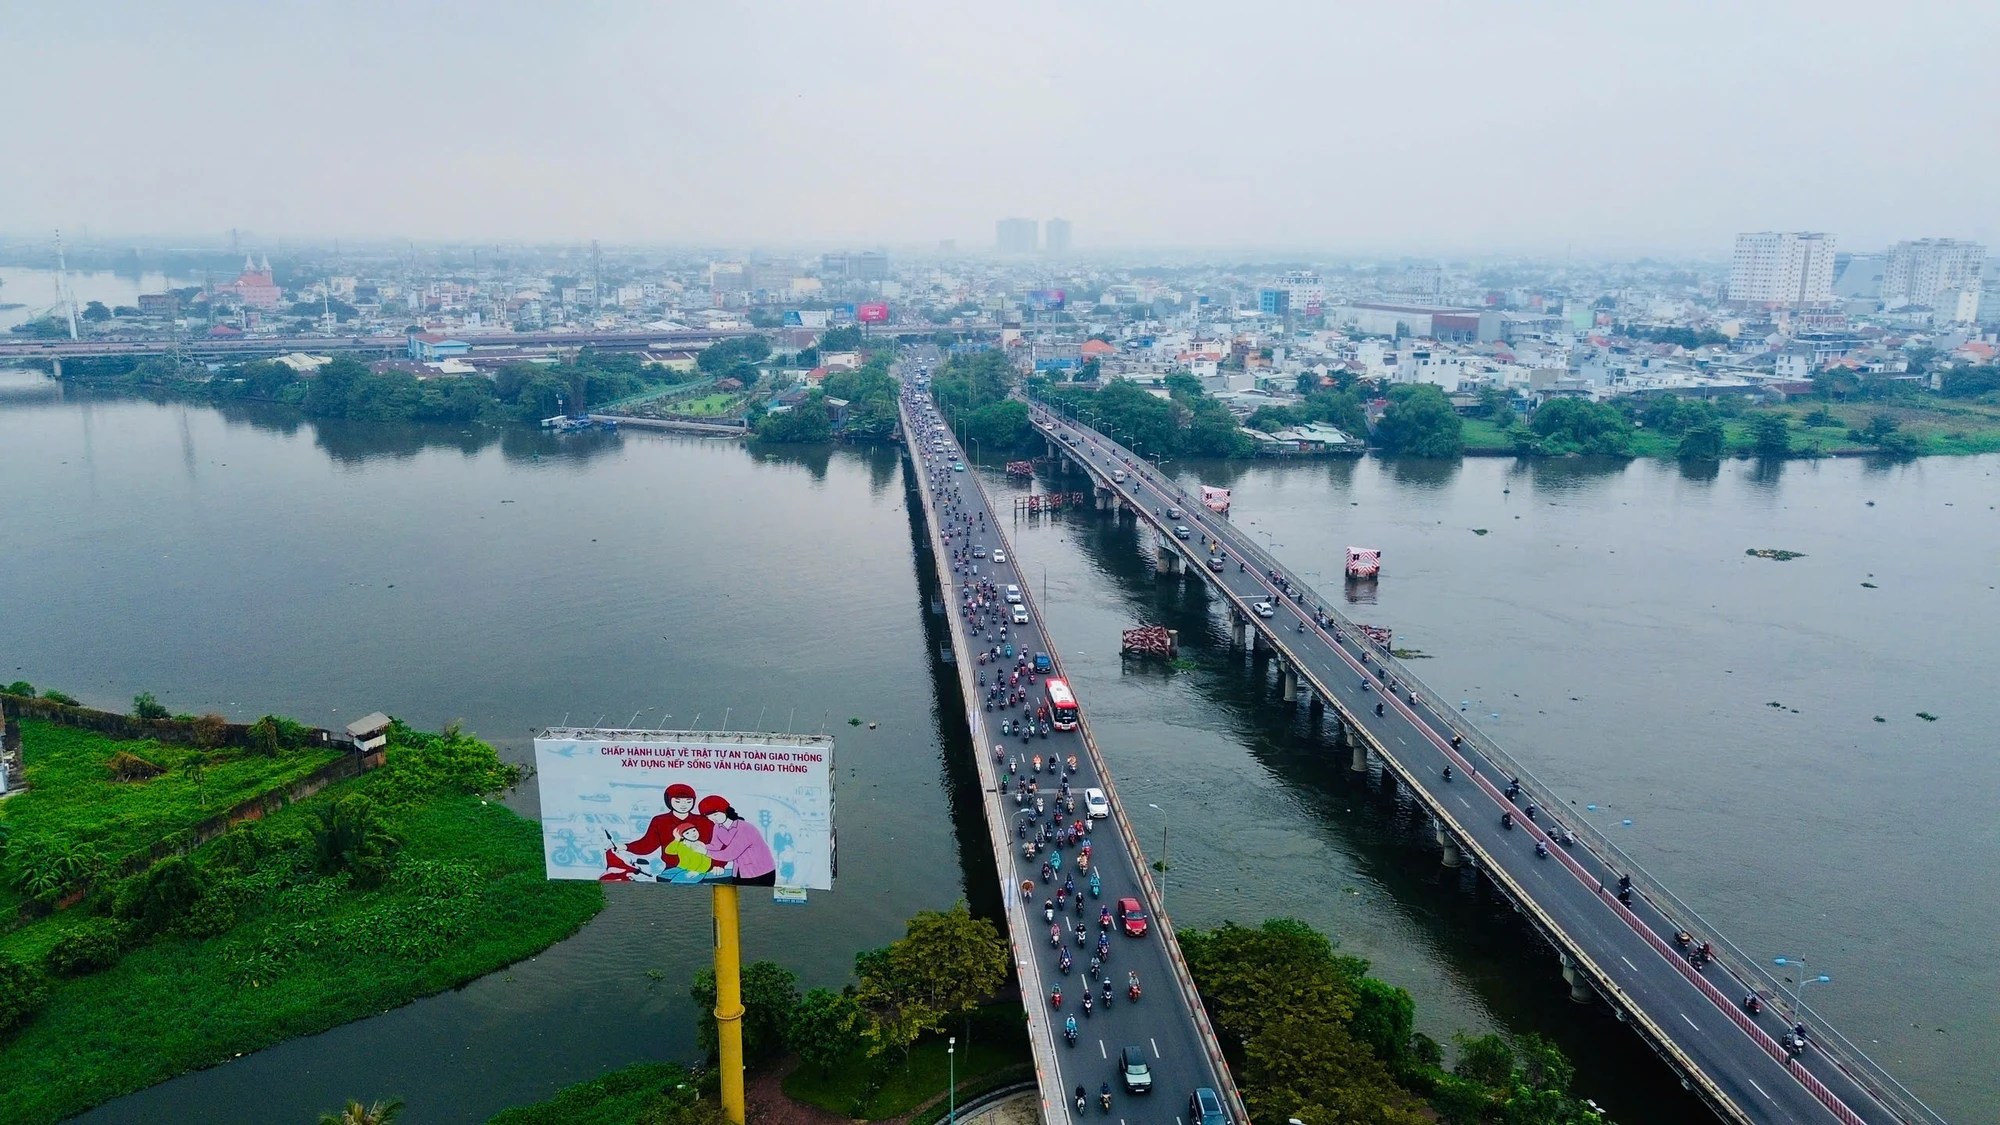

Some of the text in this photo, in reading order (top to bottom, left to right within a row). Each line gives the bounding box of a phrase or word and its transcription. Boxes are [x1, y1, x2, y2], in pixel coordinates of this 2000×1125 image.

[601, 745, 822, 762] CHẤP HÀNH LUẬT VỀ TRẬT TỰ AN TOÀN GIAO THÔNG
[621, 758, 808, 773] XÂY DỰNG NẾP SỐNG VĂN HÓA GIAO THÔNG
